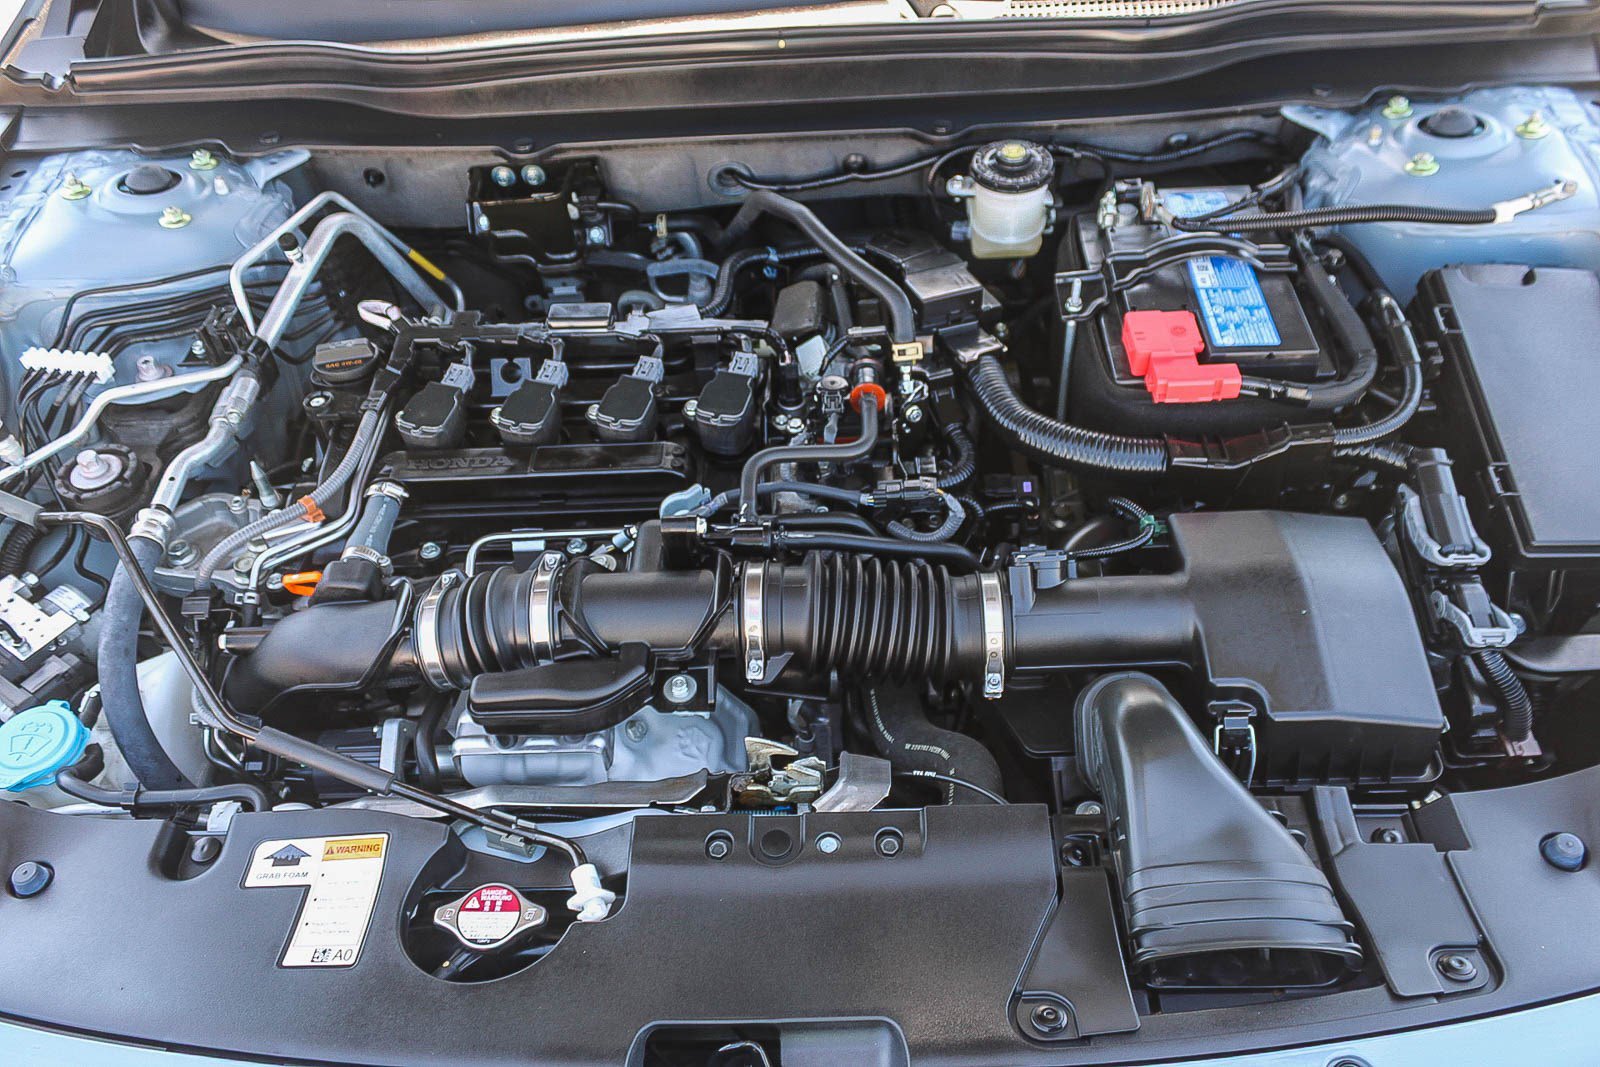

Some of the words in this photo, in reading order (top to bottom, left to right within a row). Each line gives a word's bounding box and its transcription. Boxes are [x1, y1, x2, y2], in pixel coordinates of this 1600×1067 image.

[407, 455, 514, 470] HONDA
[336, 843, 380, 854] WARNING
[256, 872, 281, 880] GRAB
[283, 871, 309, 879] FOAM
[332, 948, 354, 961] A0
